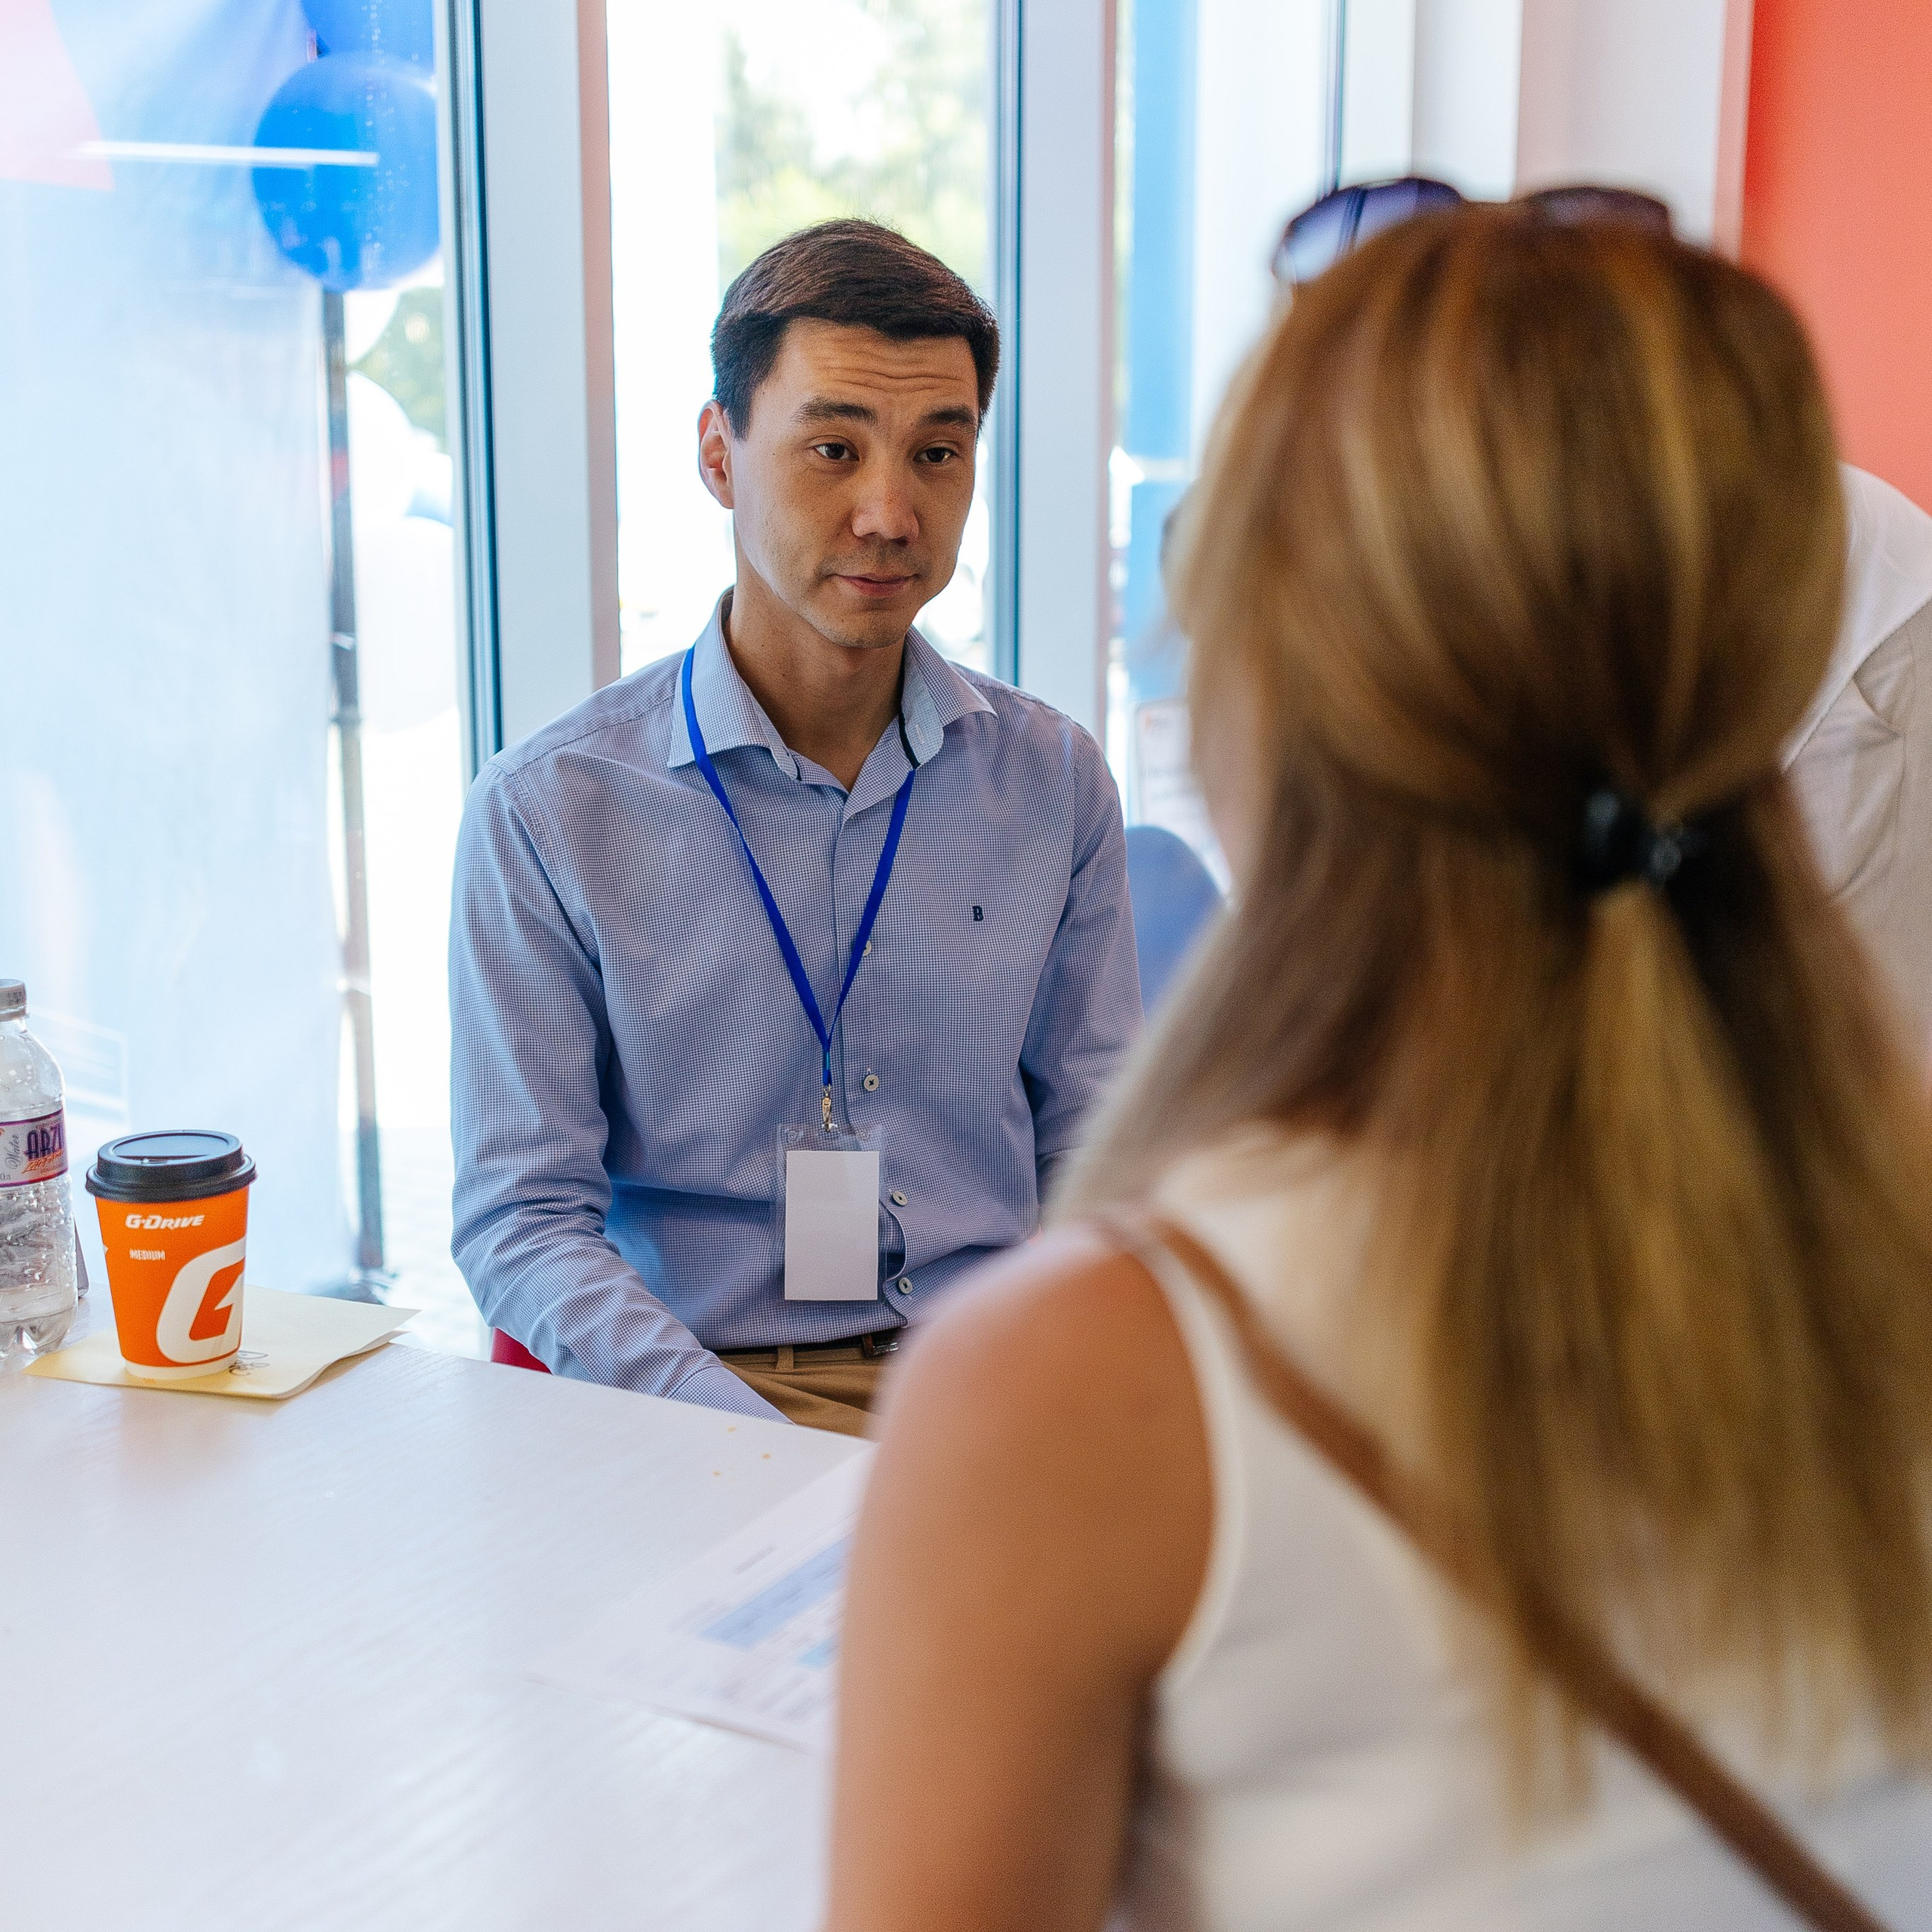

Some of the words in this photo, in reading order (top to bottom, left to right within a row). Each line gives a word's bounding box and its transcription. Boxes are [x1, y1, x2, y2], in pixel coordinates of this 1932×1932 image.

[973, 906, 984, 921] B
[5, 1134, 23, 1170] Water
[129, 1249, 166, 1261] MEDIUM
